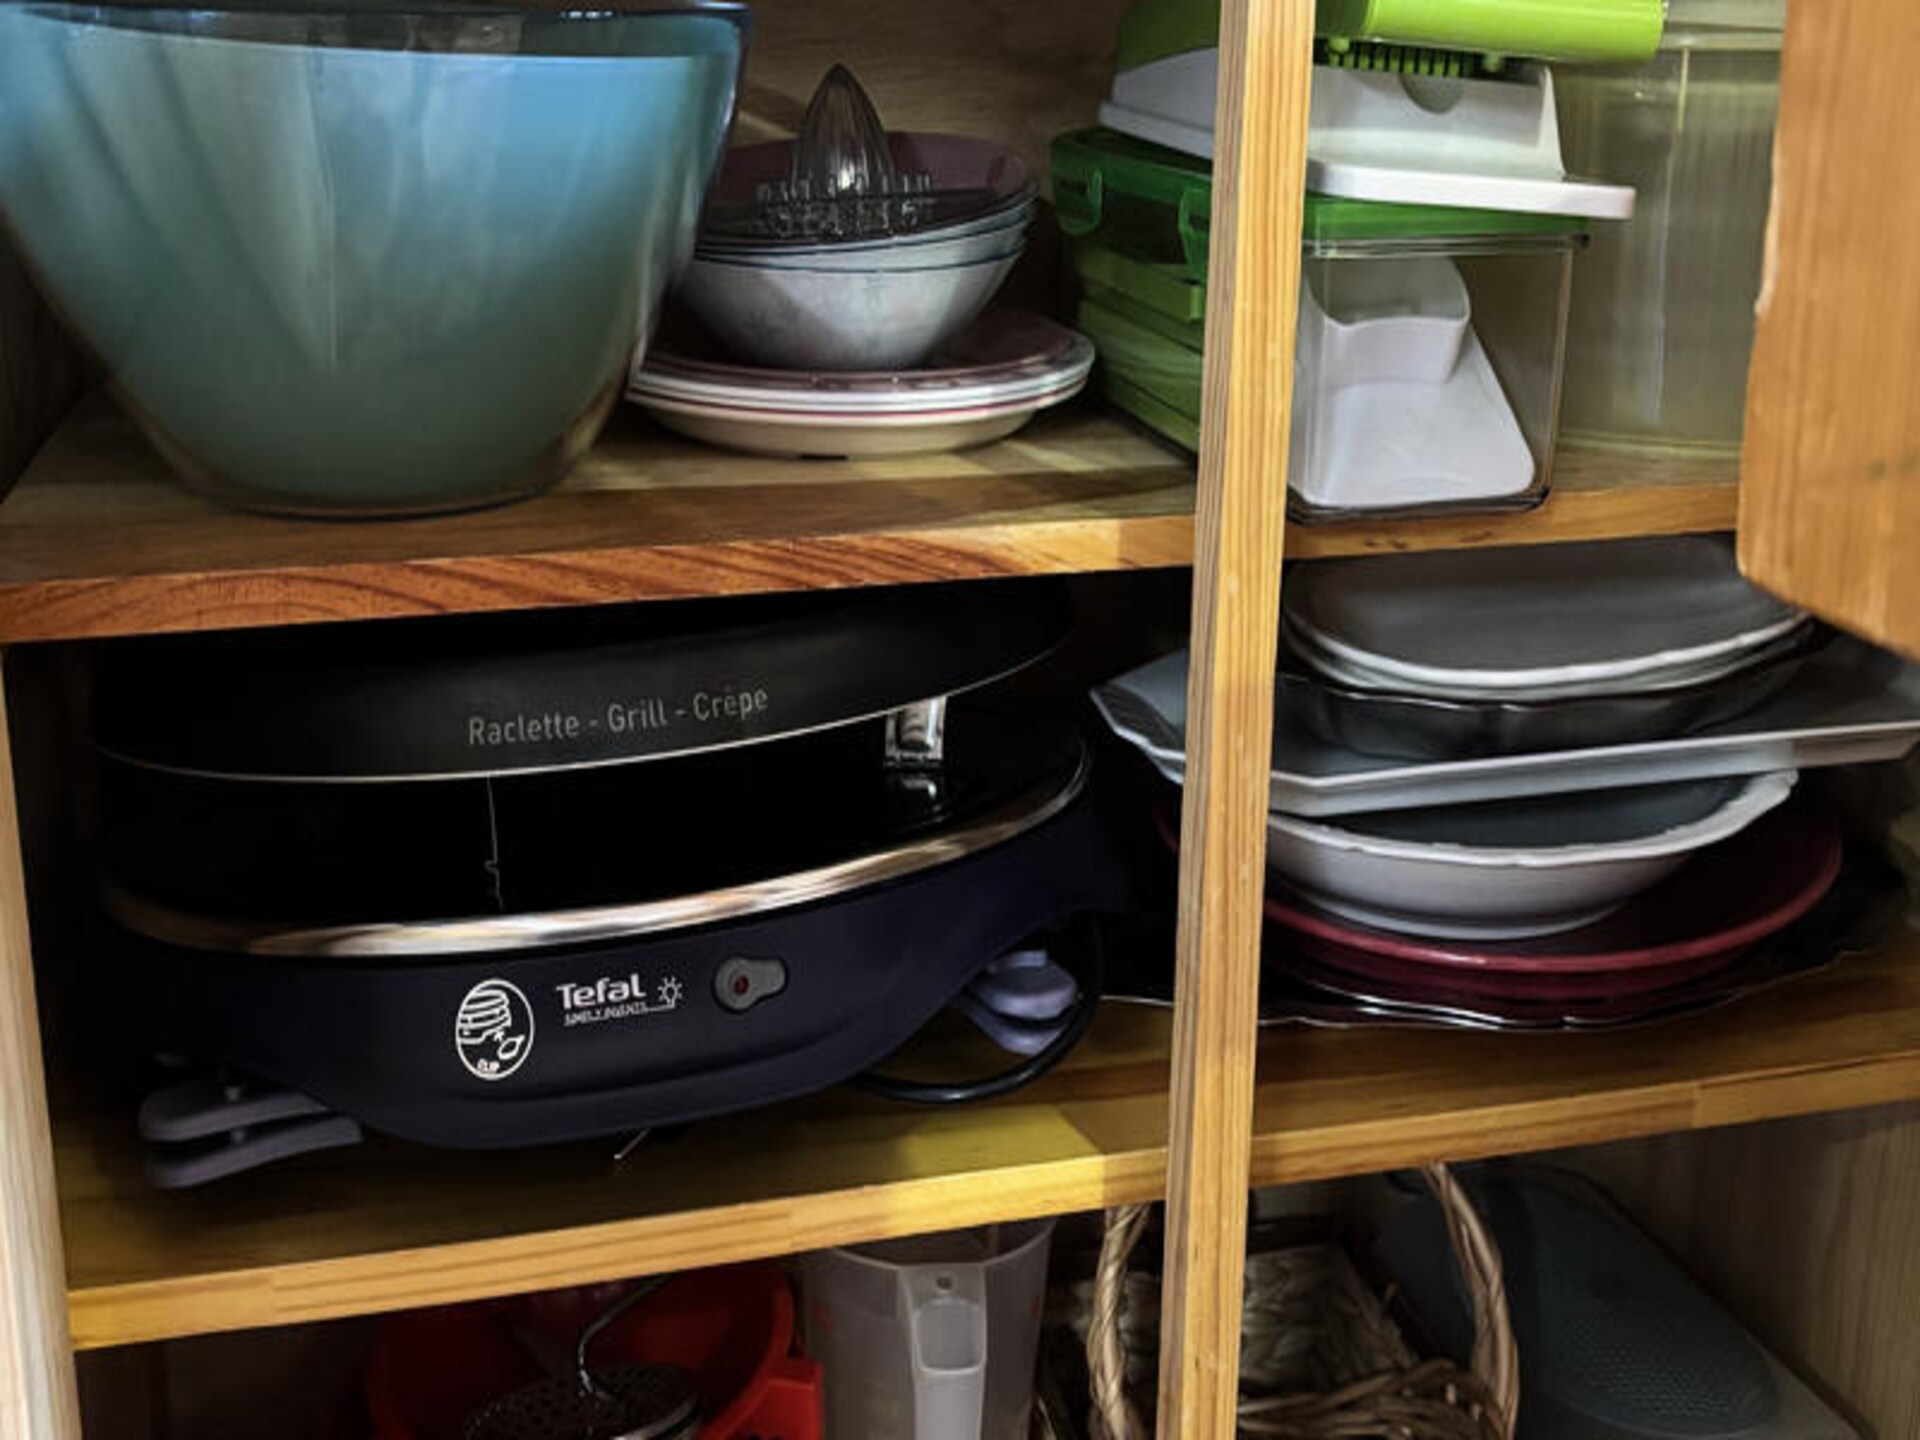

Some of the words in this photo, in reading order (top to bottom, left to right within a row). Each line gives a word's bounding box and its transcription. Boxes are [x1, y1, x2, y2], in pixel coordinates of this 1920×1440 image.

[468, 712, 580, 745] Raclette
[607, 697, 668, 733] Grill
[693, 685, 769, 722] Crêpe
[556, 973, 647, 1010] Tefal
